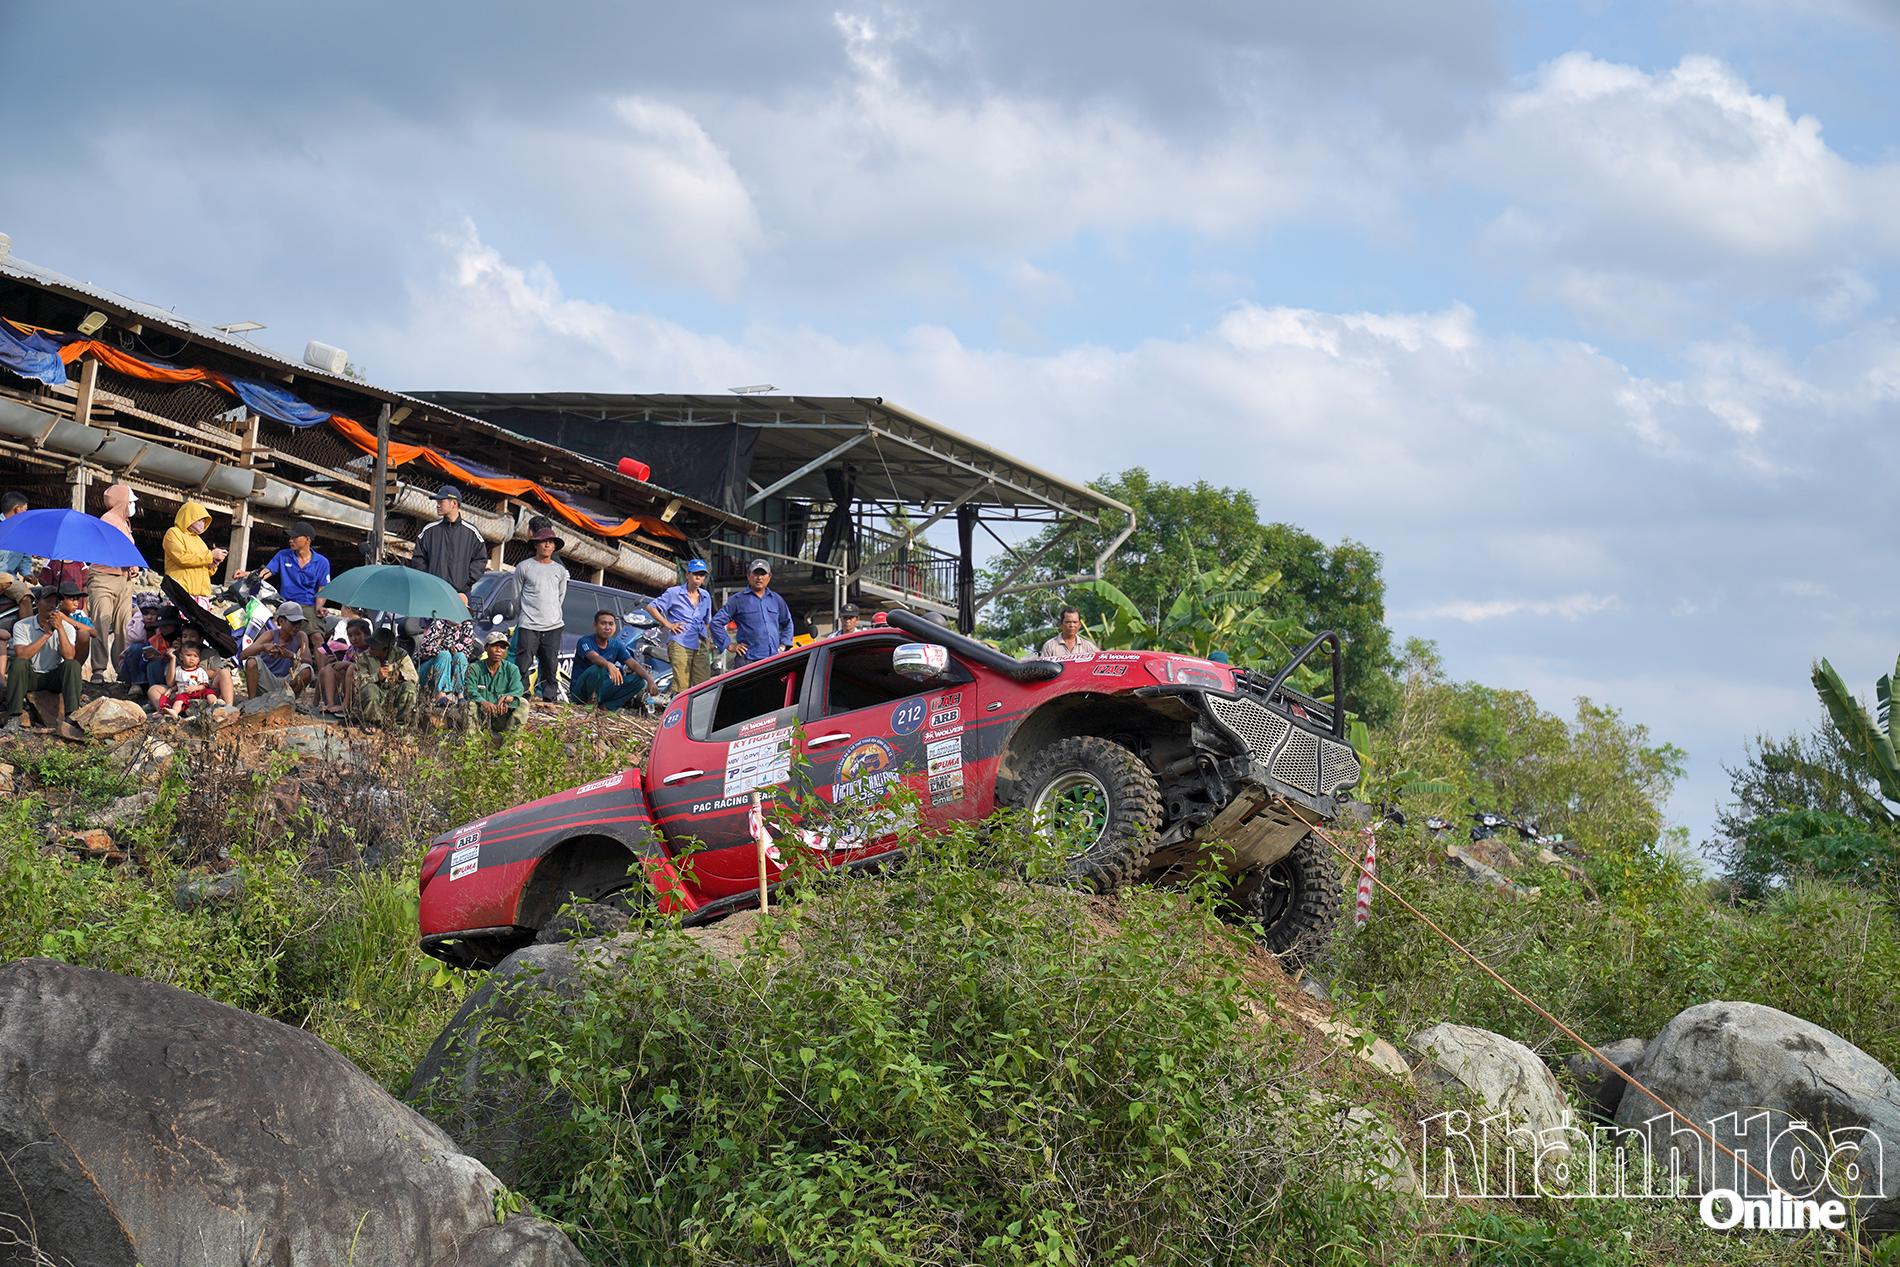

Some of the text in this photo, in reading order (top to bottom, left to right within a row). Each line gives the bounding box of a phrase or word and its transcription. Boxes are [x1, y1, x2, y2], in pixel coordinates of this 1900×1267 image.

[1096, 664, 1125, 675] PAC
[667, 713, 679, 724] 212
[898, 705, 921, 725] 212
[933, 710, 958, 726] ARB
[936, 757, 961, 770] PUMA
[930, 780, 952, 792] EMU
[693, 803, 711, 813] PAC
[714, 795, 748, 809] RACING
[458, 834, 478, 848] ARB
